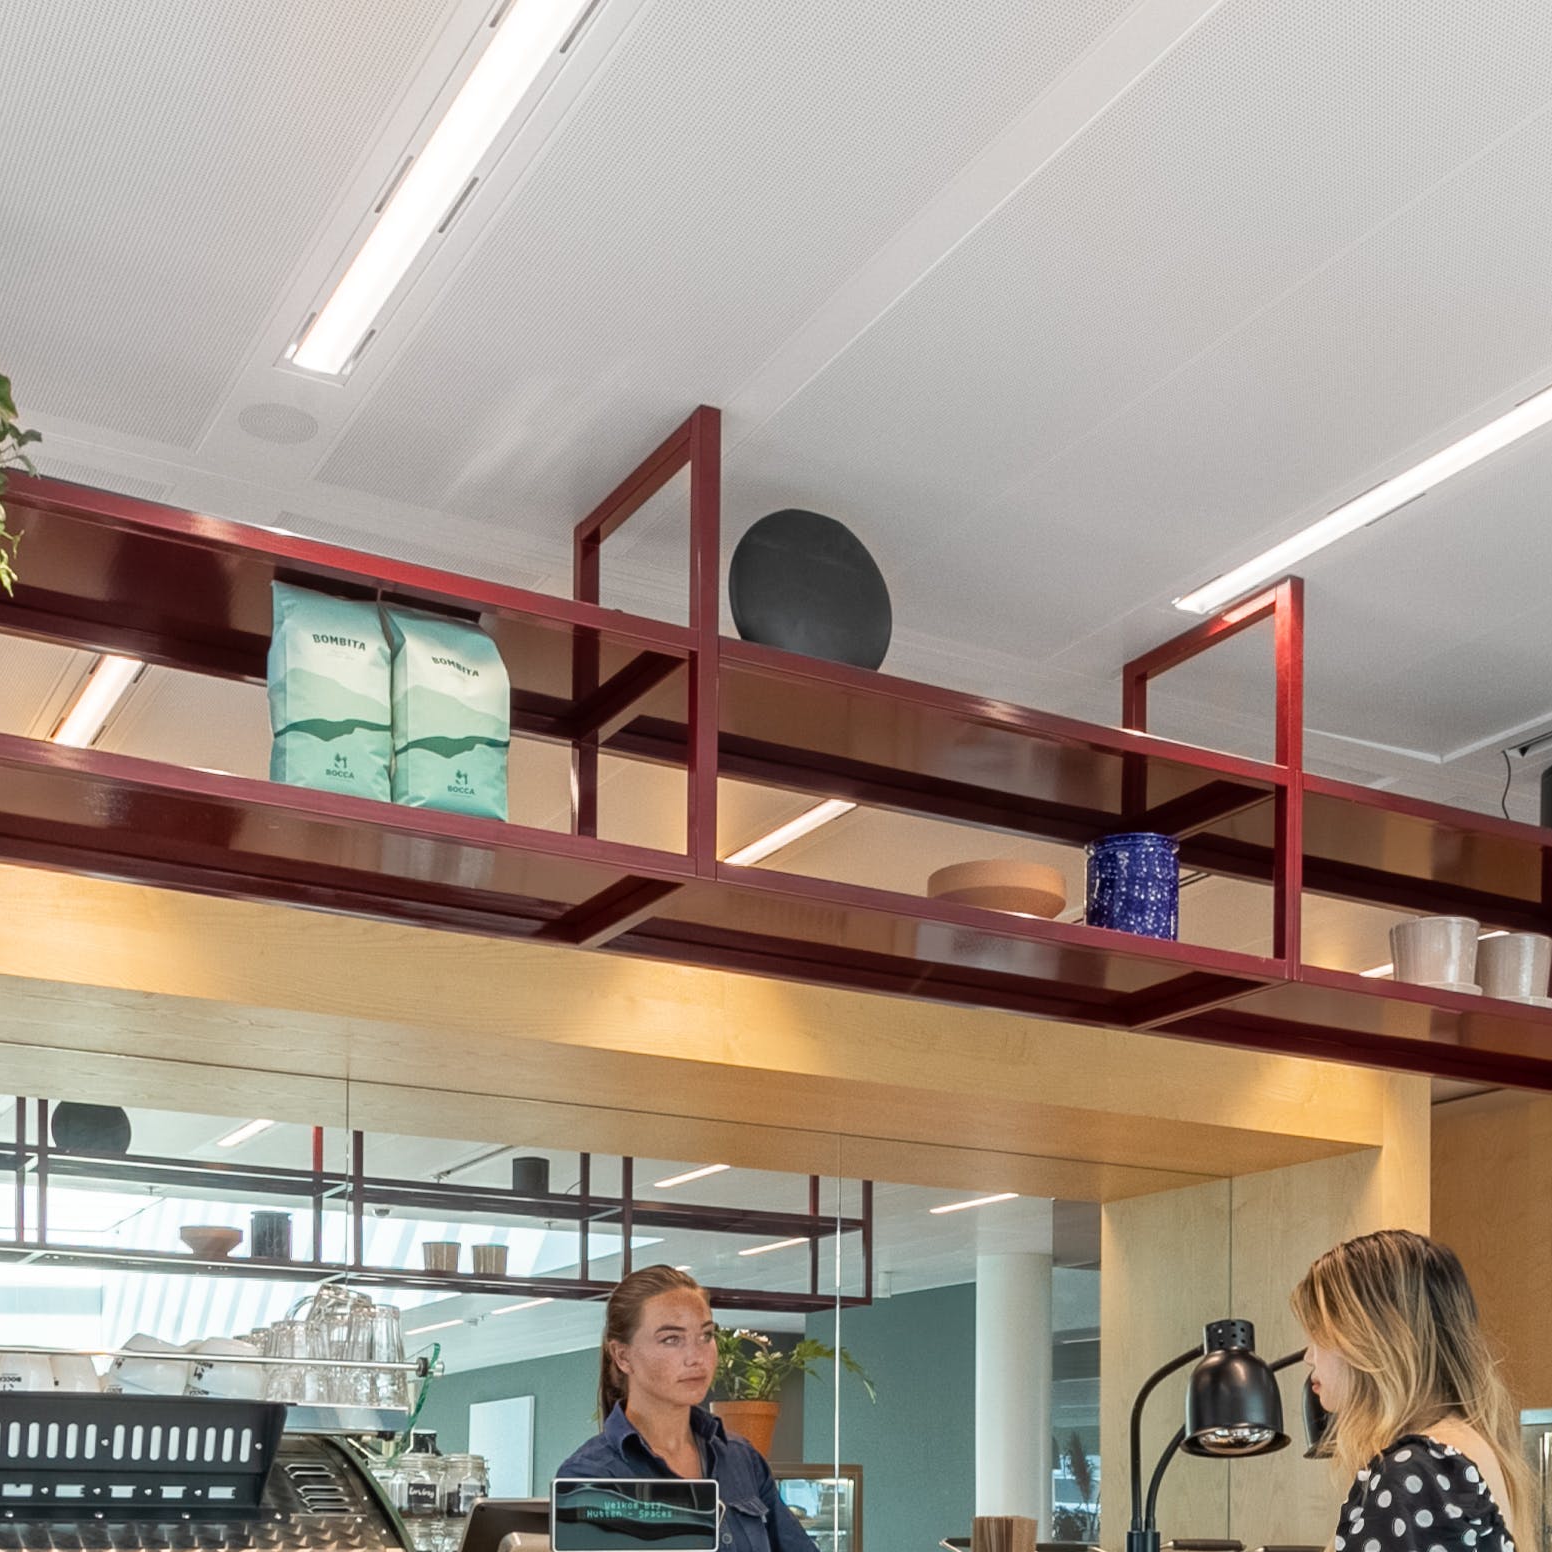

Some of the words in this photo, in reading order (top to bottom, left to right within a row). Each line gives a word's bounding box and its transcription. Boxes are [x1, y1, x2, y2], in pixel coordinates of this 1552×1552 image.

[312, 633, 366, 651] BOMBITA
[431, 656, 480, 678] BOMBITA
[325, 768, 355, 780] BOCCA
[447, 785, 475, 796] BOCCA
